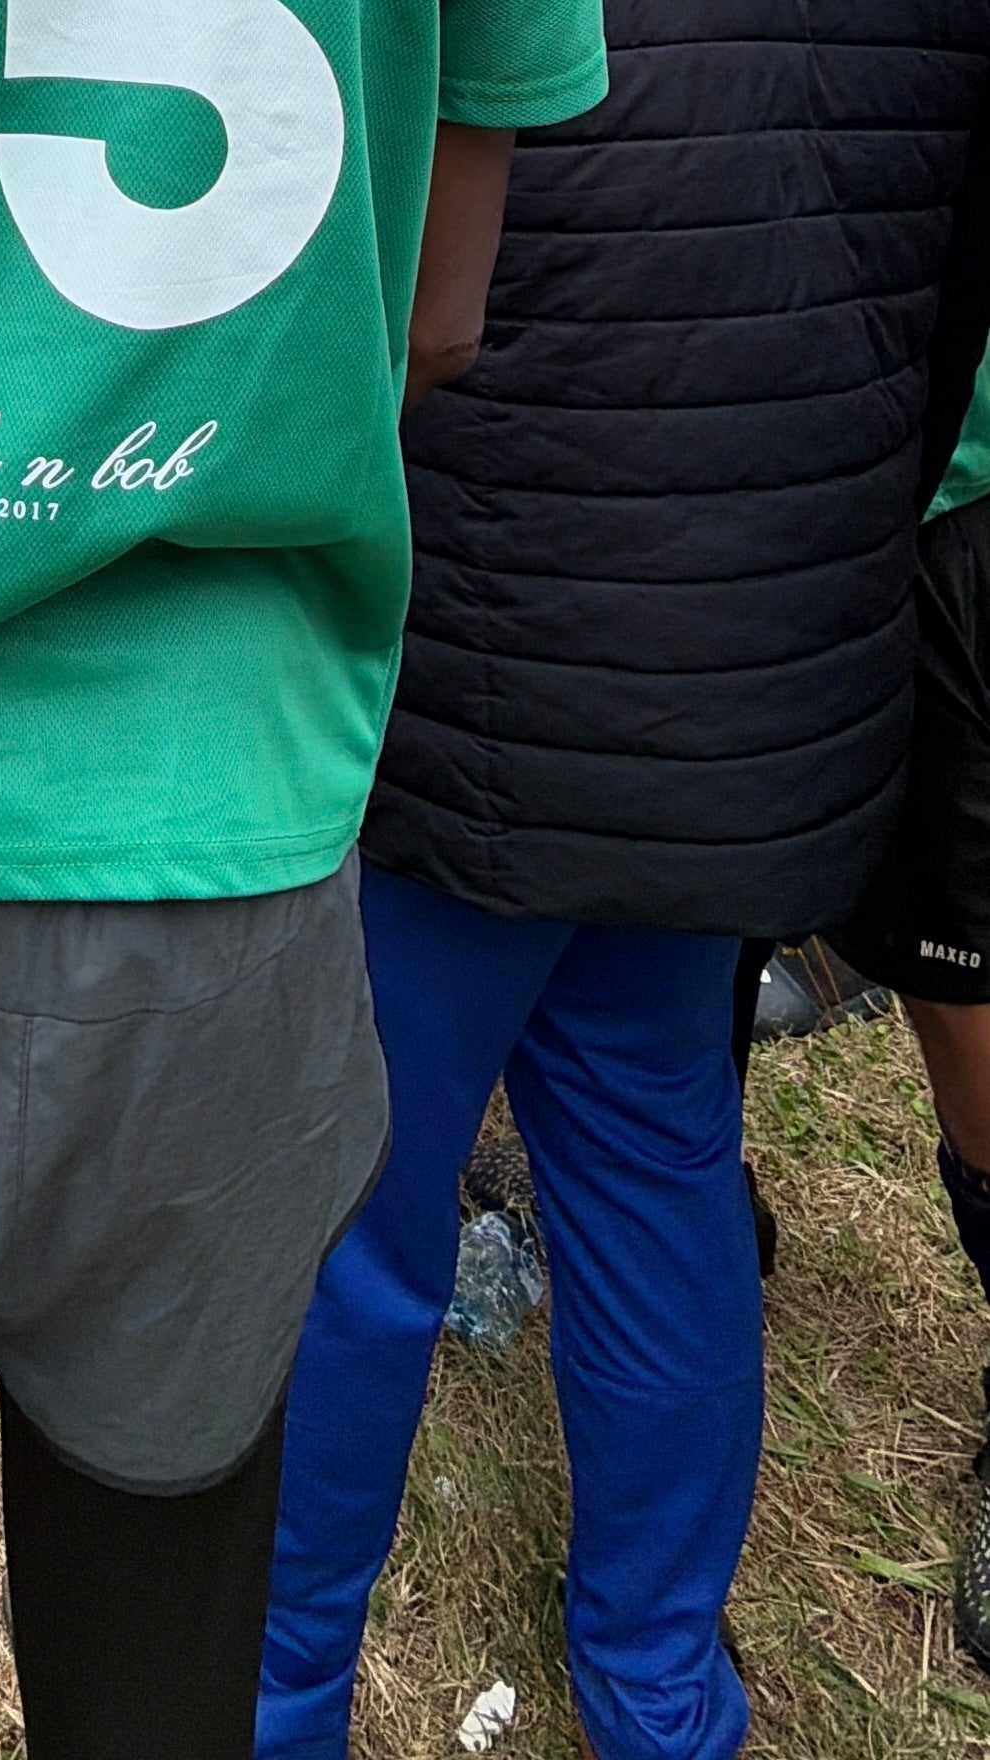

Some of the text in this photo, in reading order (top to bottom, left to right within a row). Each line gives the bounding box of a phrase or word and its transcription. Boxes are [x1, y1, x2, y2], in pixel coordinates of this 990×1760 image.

[21, 457, 75, 490] n
[91, 420, 219, 491] bob
[920, 939, 982, 968] MAXED
